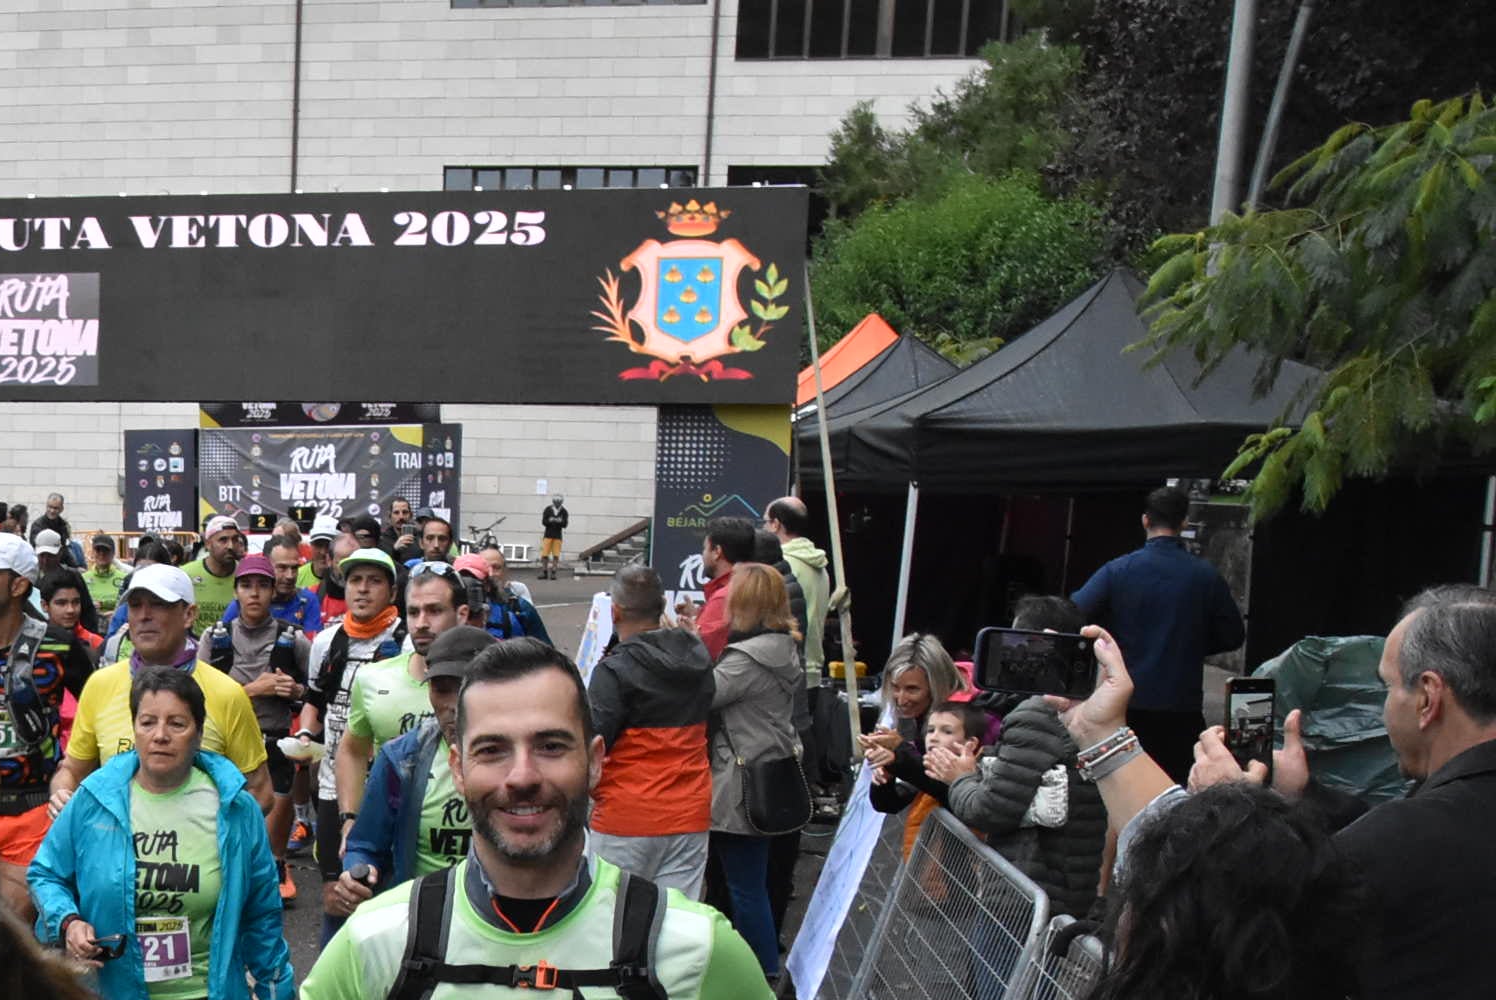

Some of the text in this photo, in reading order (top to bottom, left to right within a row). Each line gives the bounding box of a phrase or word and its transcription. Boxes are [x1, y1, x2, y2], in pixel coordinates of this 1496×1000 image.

[128, 212, 375, 249] VETONA
[392, 210, 547, 247] 2025
[290, 443, 337, 473] RUTA
[219, 485, 243, 502] BTT
[280, 472, 357, 500] VETONA
[143, 493, 171, 512] RUTA
[137, 511, 183, 529] VETONA
[257, 516, 266, 528] 2
[135, 860, 200, 893] ETONA
[138, 935, 175, 962] 21
